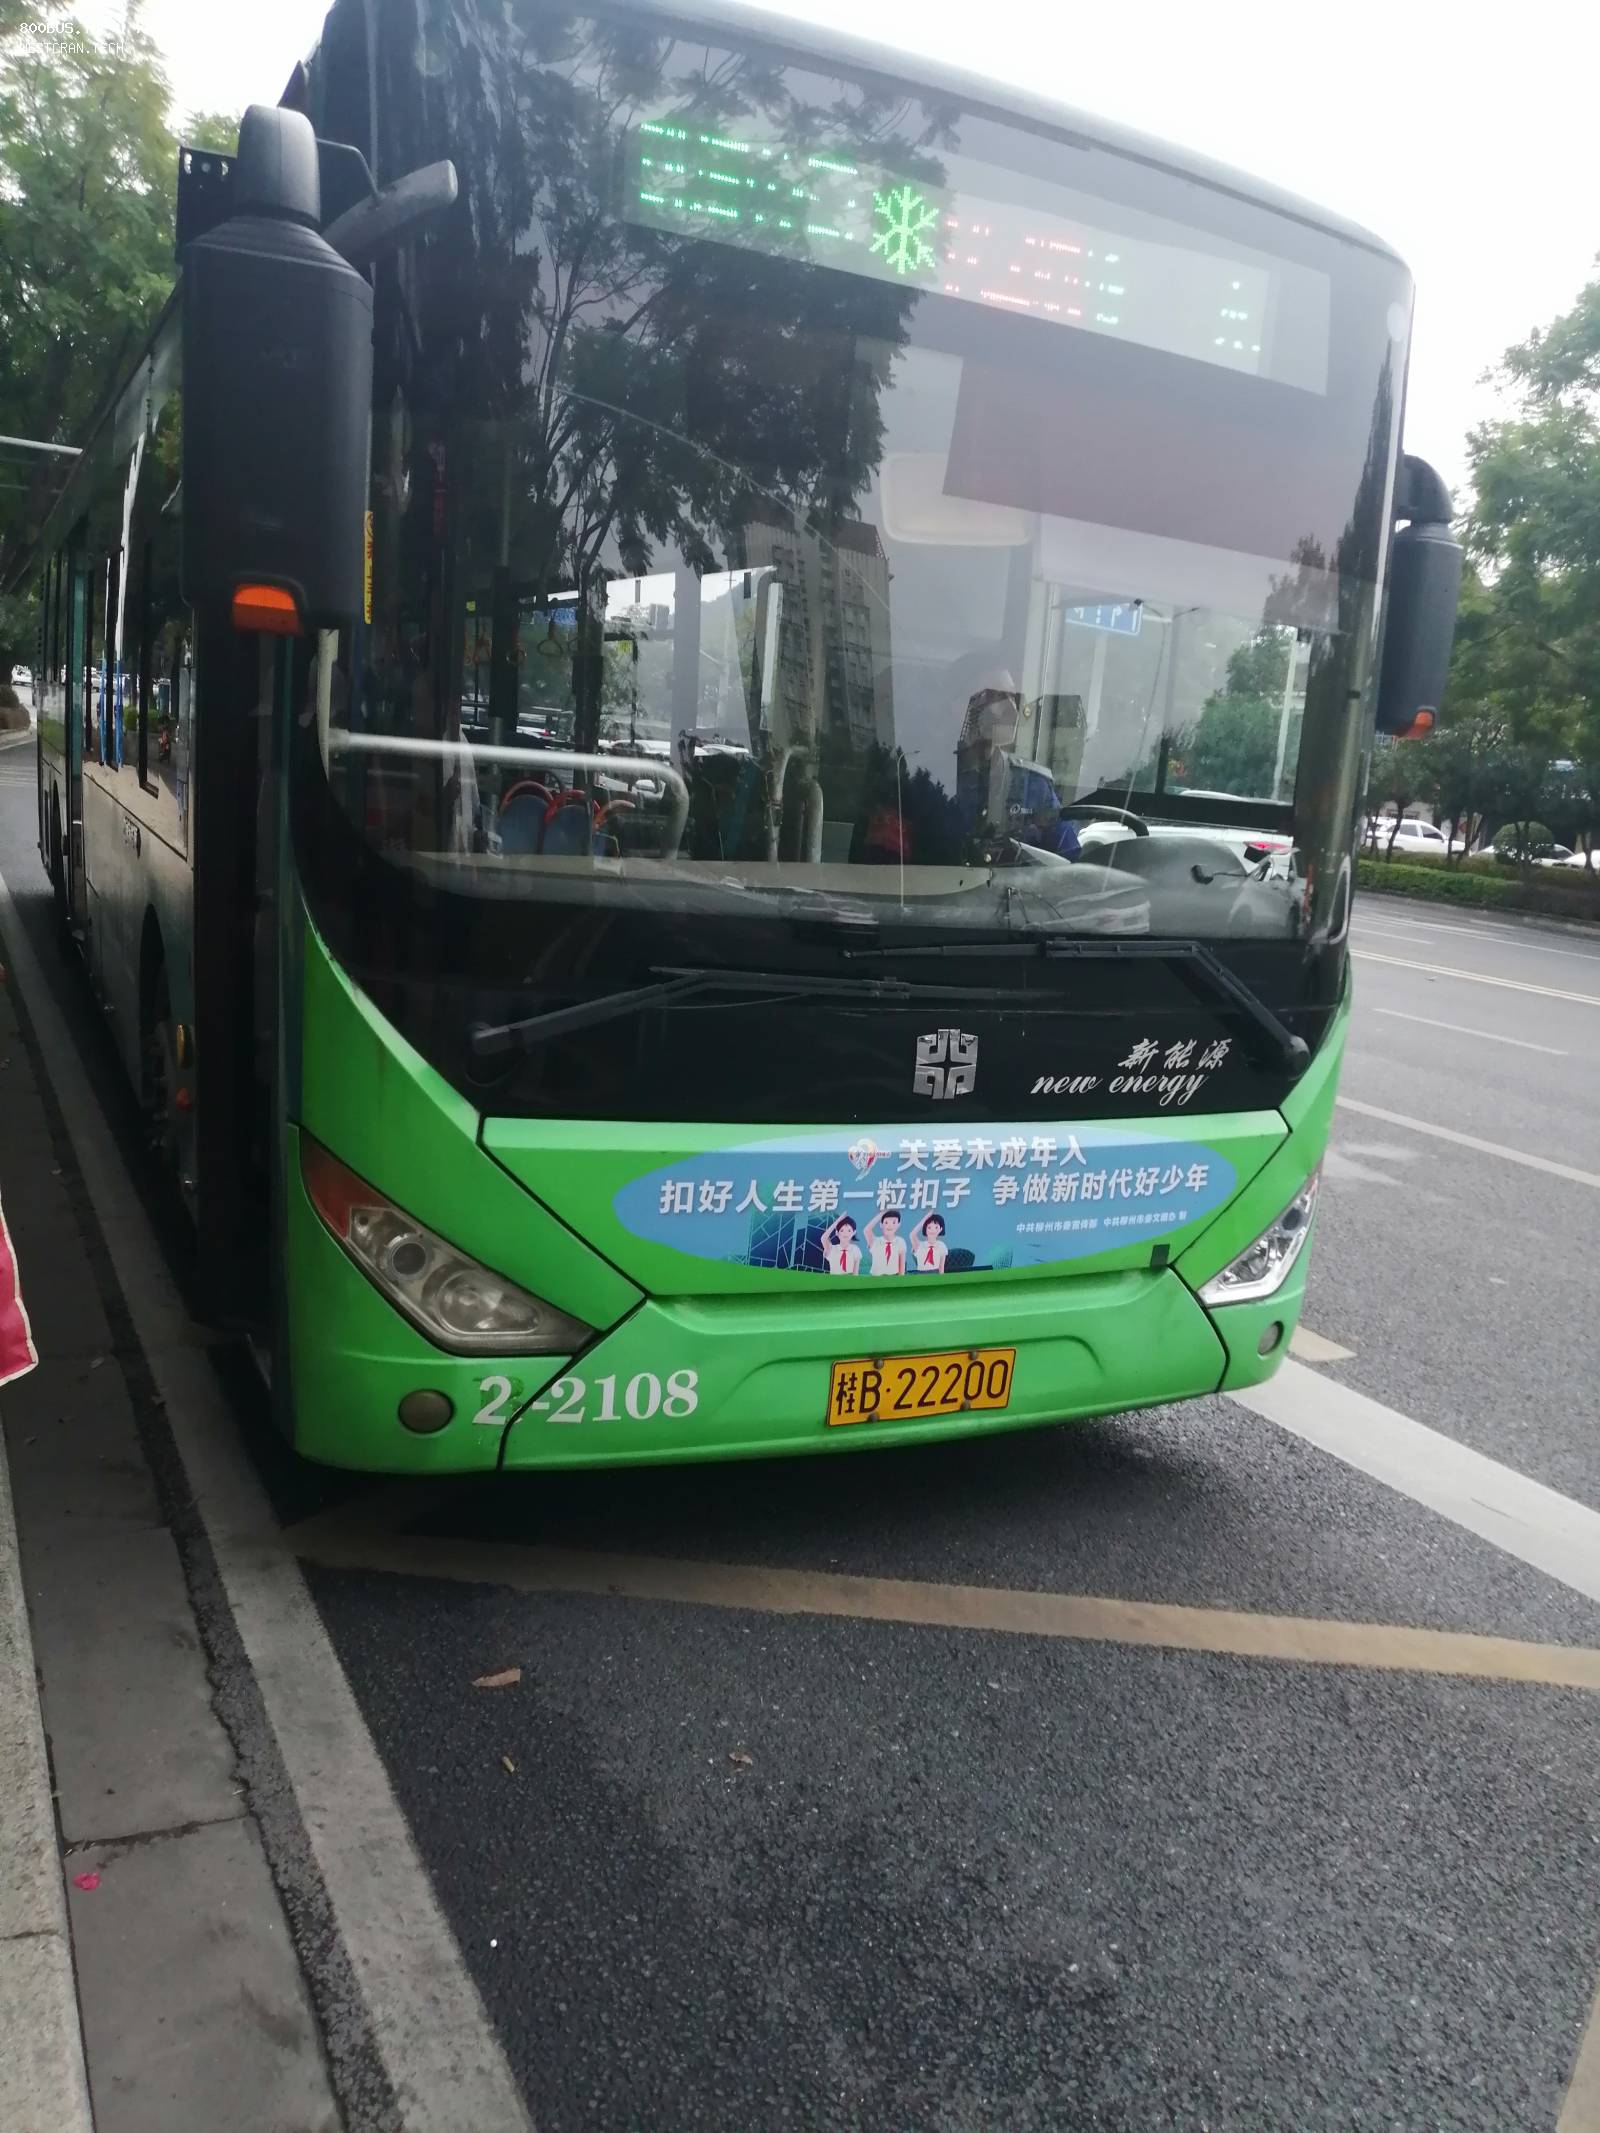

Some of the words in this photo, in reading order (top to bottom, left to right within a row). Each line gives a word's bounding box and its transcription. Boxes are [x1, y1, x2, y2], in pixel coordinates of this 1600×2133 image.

[1117, 1037, 1233, 1071] 新能源
[1030, 1072, 1102, 1095] new
[1109, 1071, 1211, 1107] energy
[896, 1135, 1088, 1172] 关爱未成年人
[659, 1177, 972, 1214] 扣好人生第一粒扣子
[992, 1163, 1210, 1206] 争做新时代好少年
[472, 1369, 699, 1425] 2-2108
